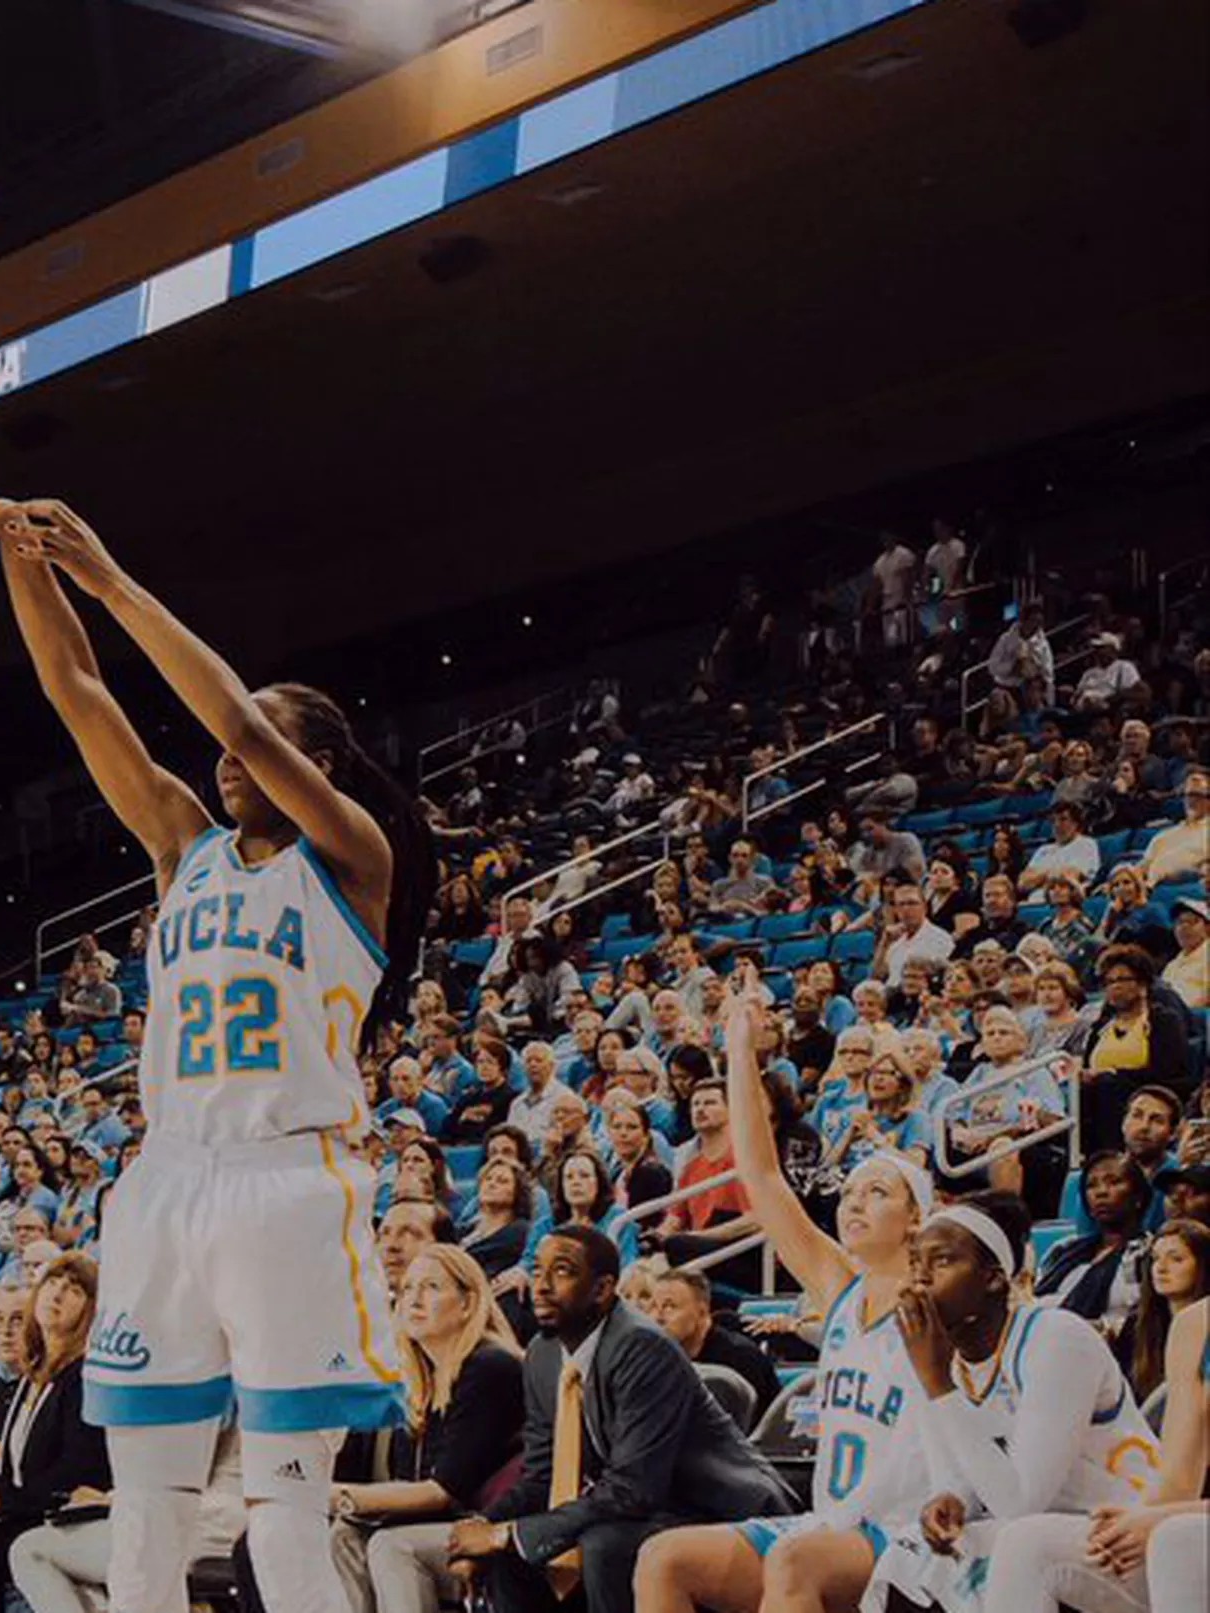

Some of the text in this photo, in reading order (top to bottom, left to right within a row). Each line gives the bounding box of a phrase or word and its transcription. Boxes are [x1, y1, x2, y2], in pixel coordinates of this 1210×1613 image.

[157, 893, 306, 971] UCLA
[177, 973, 282, 1080] 22
[827, 1432, 867, 1501] 0
